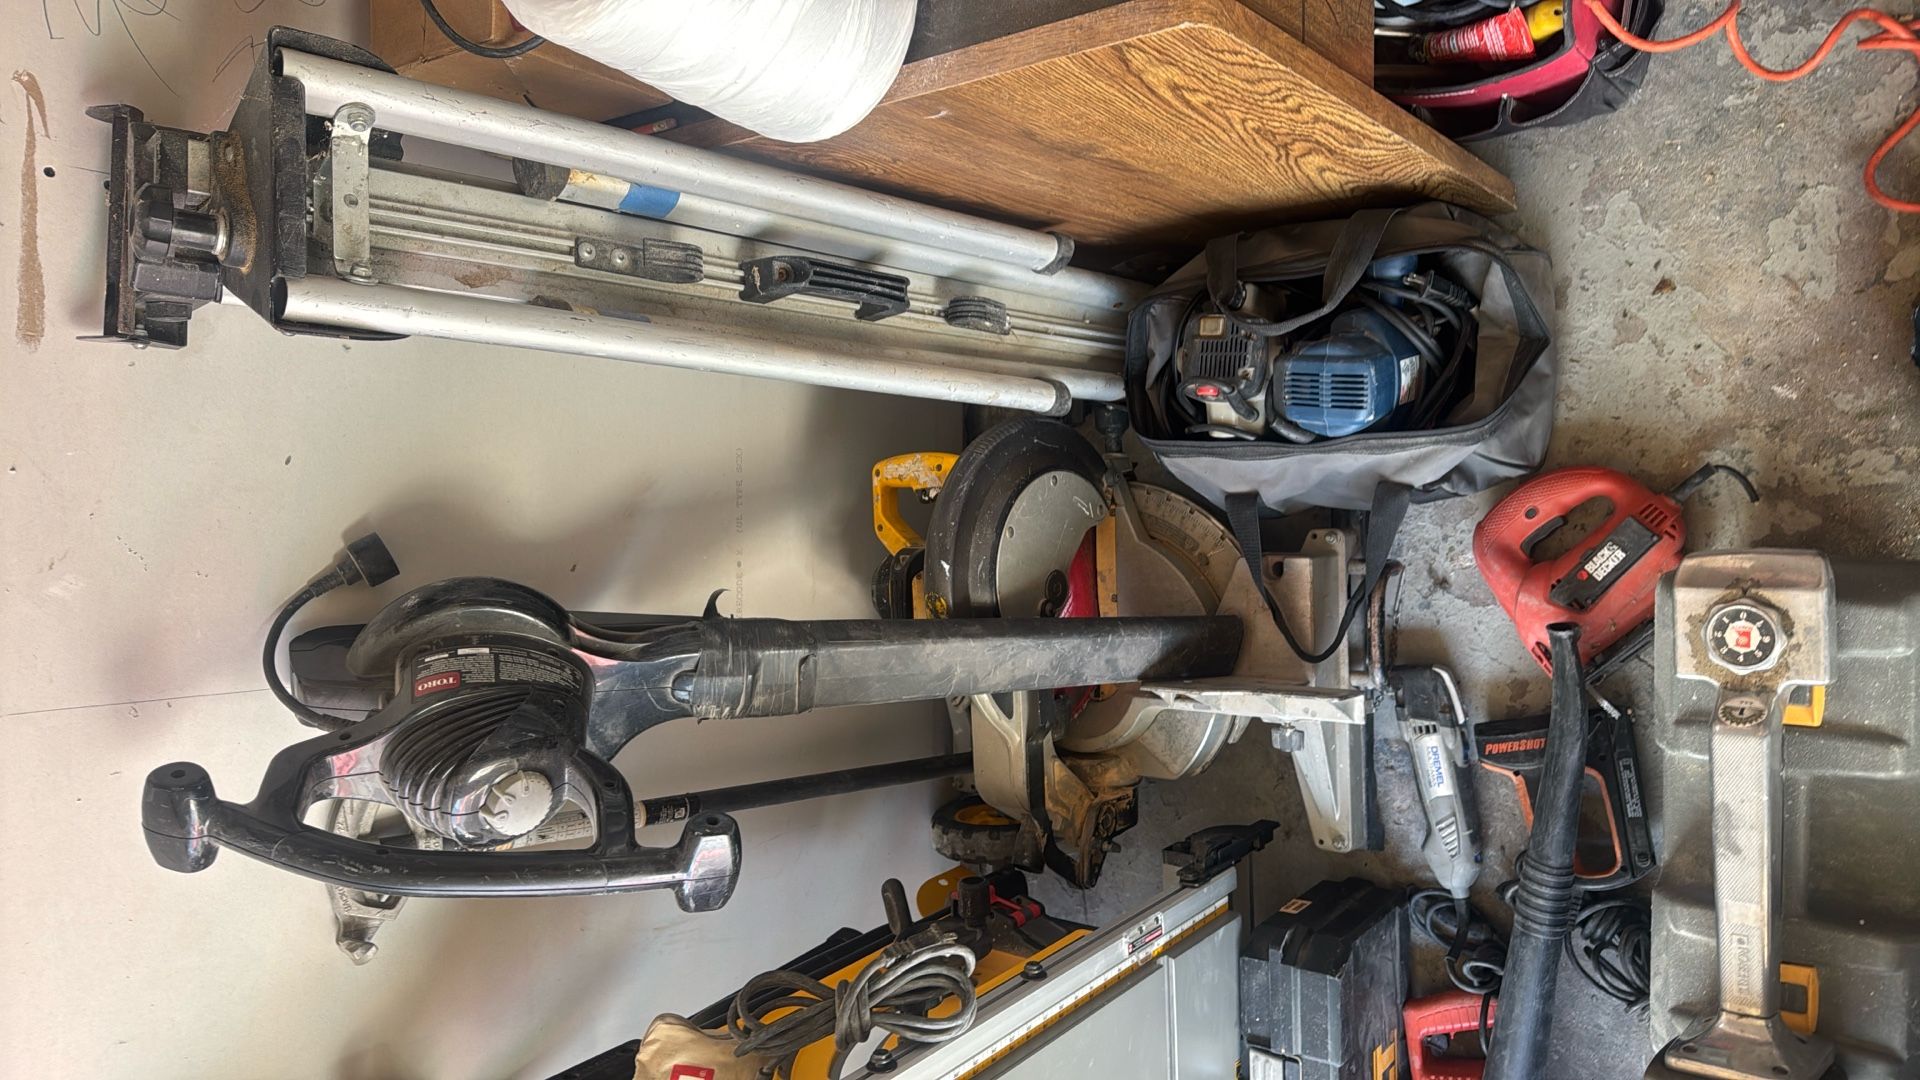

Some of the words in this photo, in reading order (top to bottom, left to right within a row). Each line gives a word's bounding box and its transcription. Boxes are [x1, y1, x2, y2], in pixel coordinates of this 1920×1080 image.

[735, 479, 744, 509] TYPE
[1592, 547, 1627, 582] DECKER
[416, 676, 457, 692] TORO
[1484, 737, 1546, 756] POWERSHOT
[1430, 745, 1444, 788] DREMEL
